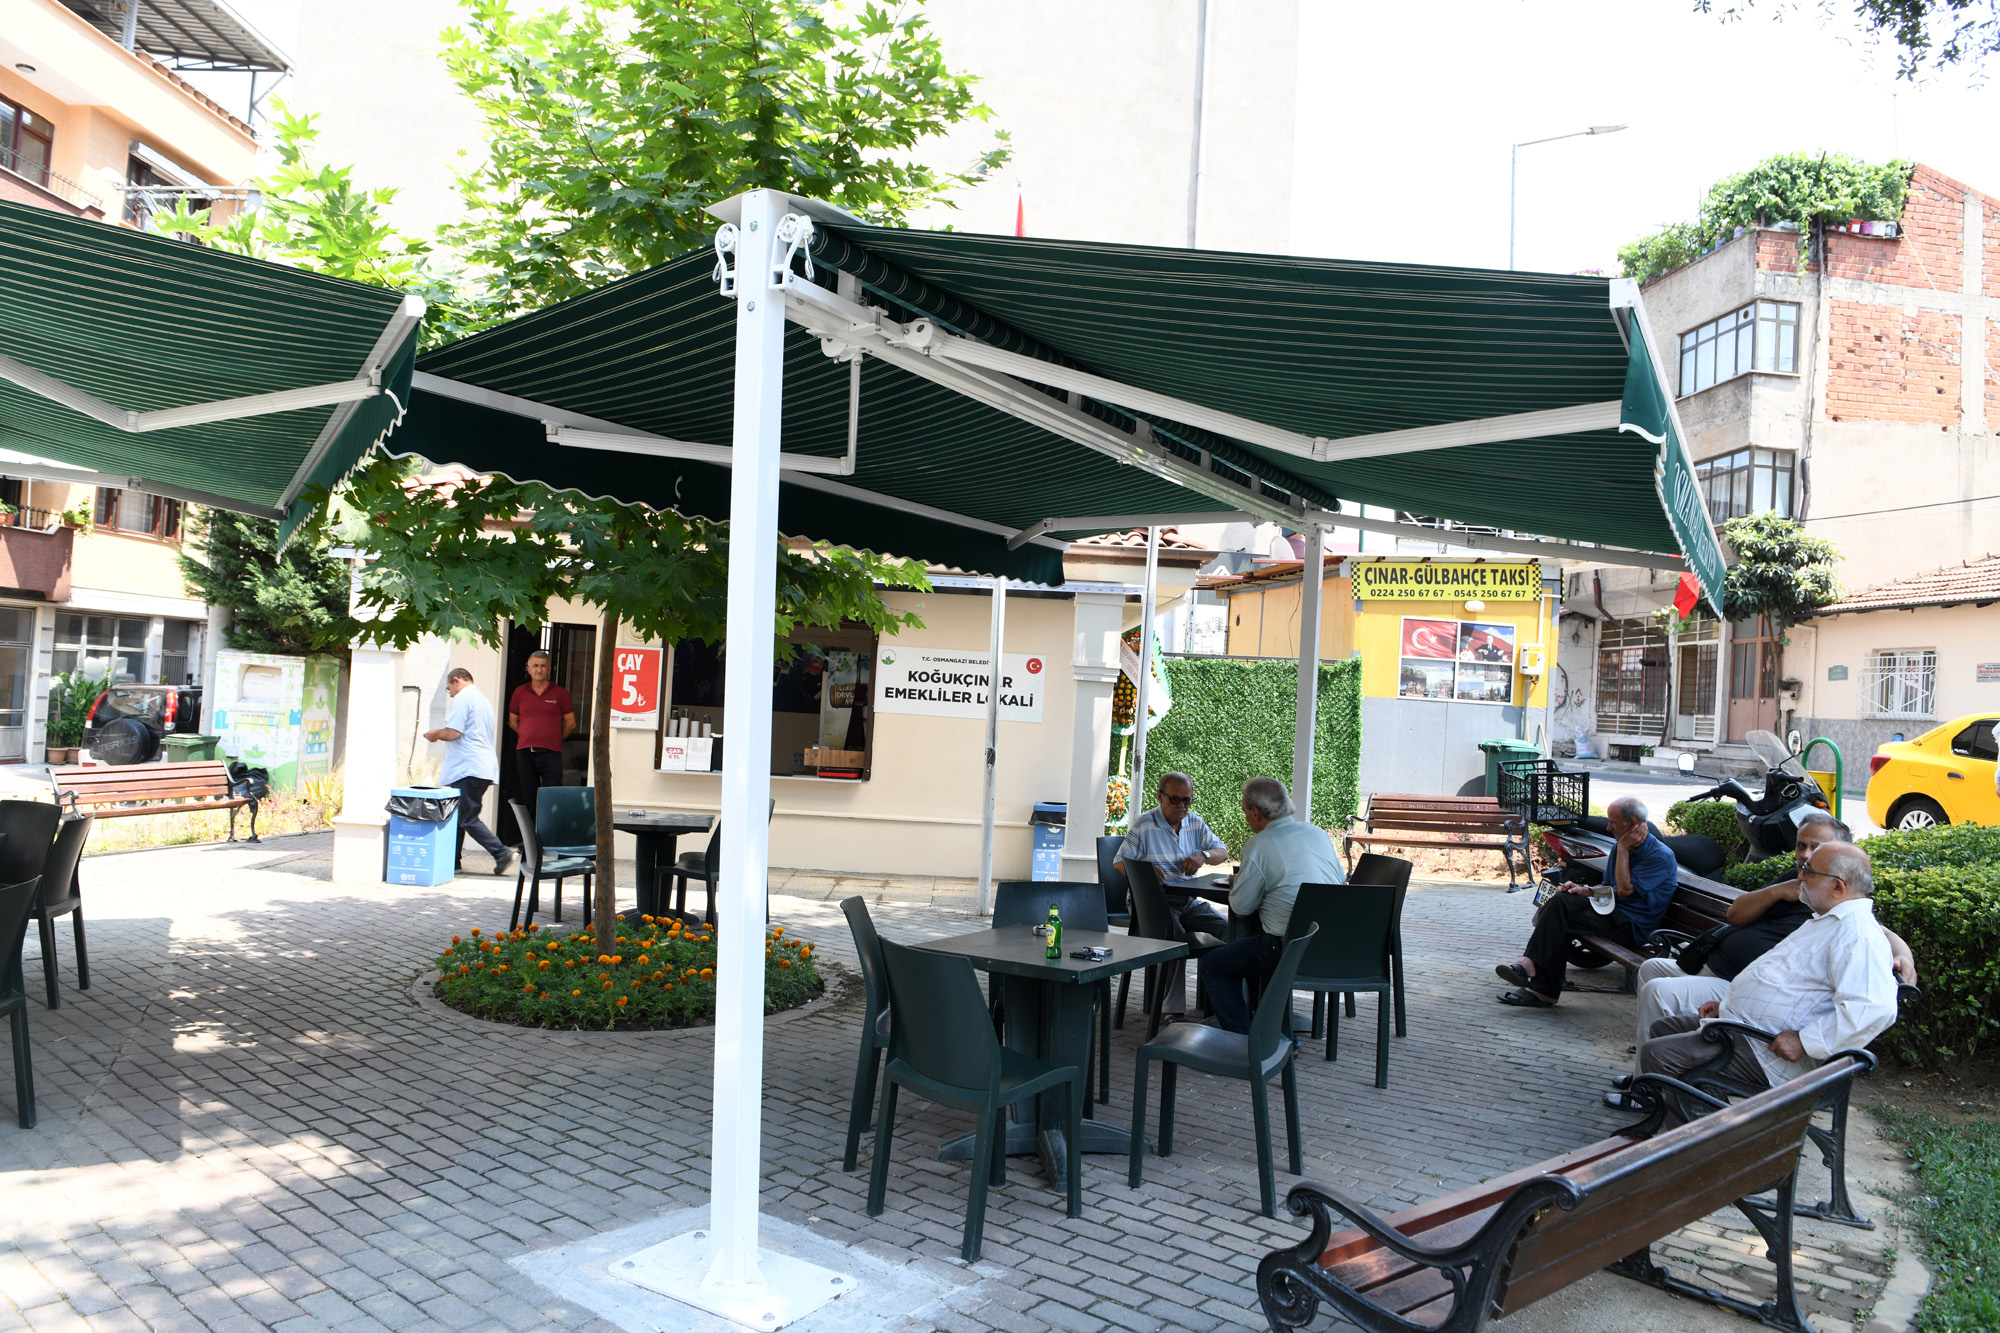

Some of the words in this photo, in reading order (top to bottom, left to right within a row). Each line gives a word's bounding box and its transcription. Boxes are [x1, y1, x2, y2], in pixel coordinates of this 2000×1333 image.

[1364, 564, 1487, 587] ÇINAR-GÜLBAHÇE
[1490, 565, 1530, 586] TAKSİ
[1370, 588, 1395, 597] 0224
[1397, 588, 1416, 597] 250
[1418, 589, 1430, 597] 67
[1433, 589, 1445, 597] 67
[1454, 589, 1478, 598] 0545
[1480, 589, 1498, 598] 250
[1501, 590, 1512, 598] 67
[1515, 590, 1527, 598] 67
[617, 653, 644, 672] ÇAY
[908, 668, 1013, 688] KOĞUKÇINR
[884, 686, 972, 704] EMEKLİLER
[976, 693, 1034, 708] LKALİ
[99, 735, 140, 751] TERIOS
